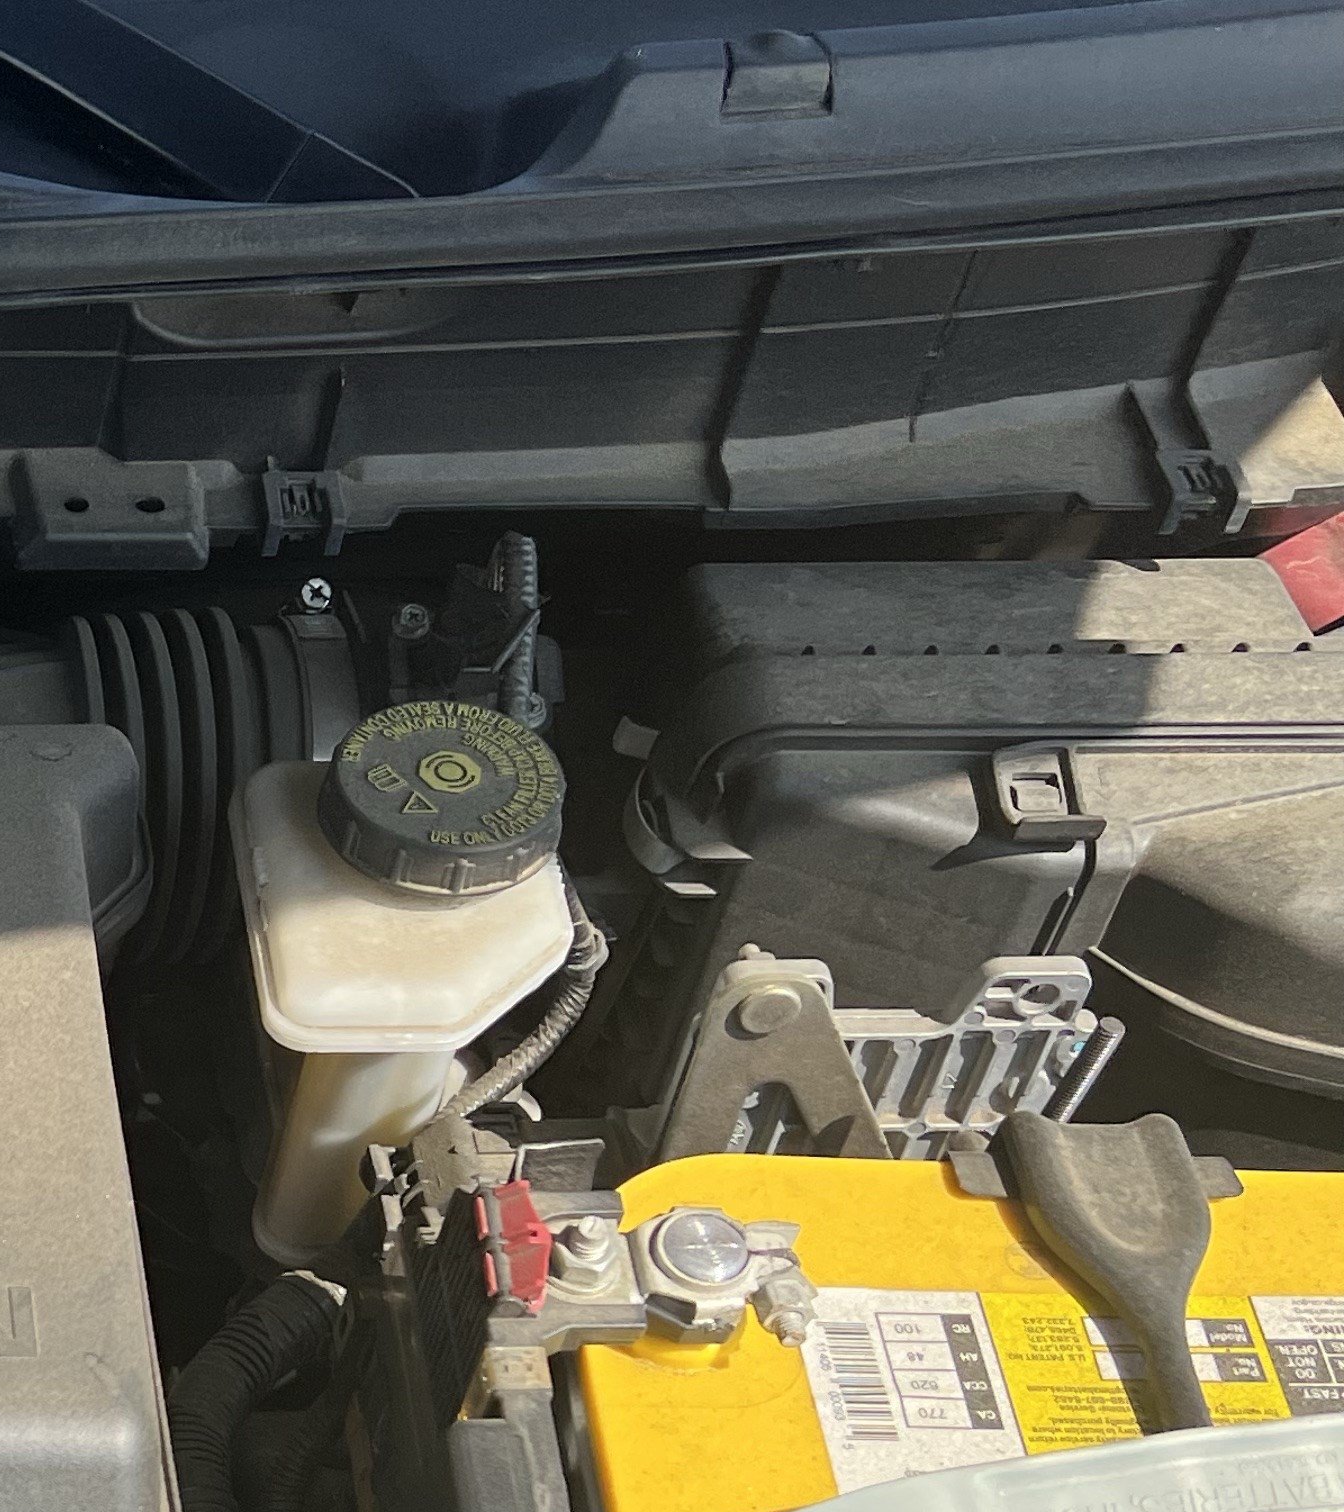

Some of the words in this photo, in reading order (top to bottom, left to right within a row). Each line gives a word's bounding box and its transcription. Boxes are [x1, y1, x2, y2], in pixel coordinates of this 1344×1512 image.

[381, 699, 440, 723] SEALED
[442, 701, 453, 713] A
[457, 701, 501, 725] FROM
[378, 713, 458, 743] REMOVING
[428, 829, 460, 845] USE
[894, 1323, 921, 1334] 100
[951, 1323, 972, 1333] RC
[1209, 1332, 1248, 1342] Model
[1274, 1345, 1318, 1355] OPEN.
[959, 1351, 979, 1362] AH
[1287, 1356, 1316, 1367] NOT
[1232, 1367, 1261, 1377] Part
[1295, 1368, 1316, 1379] DO
[963, 1380, 988, 1391] CCA
[918, 1407, 948, 1420] 770
[976, 1409, 996, 1420] CA
